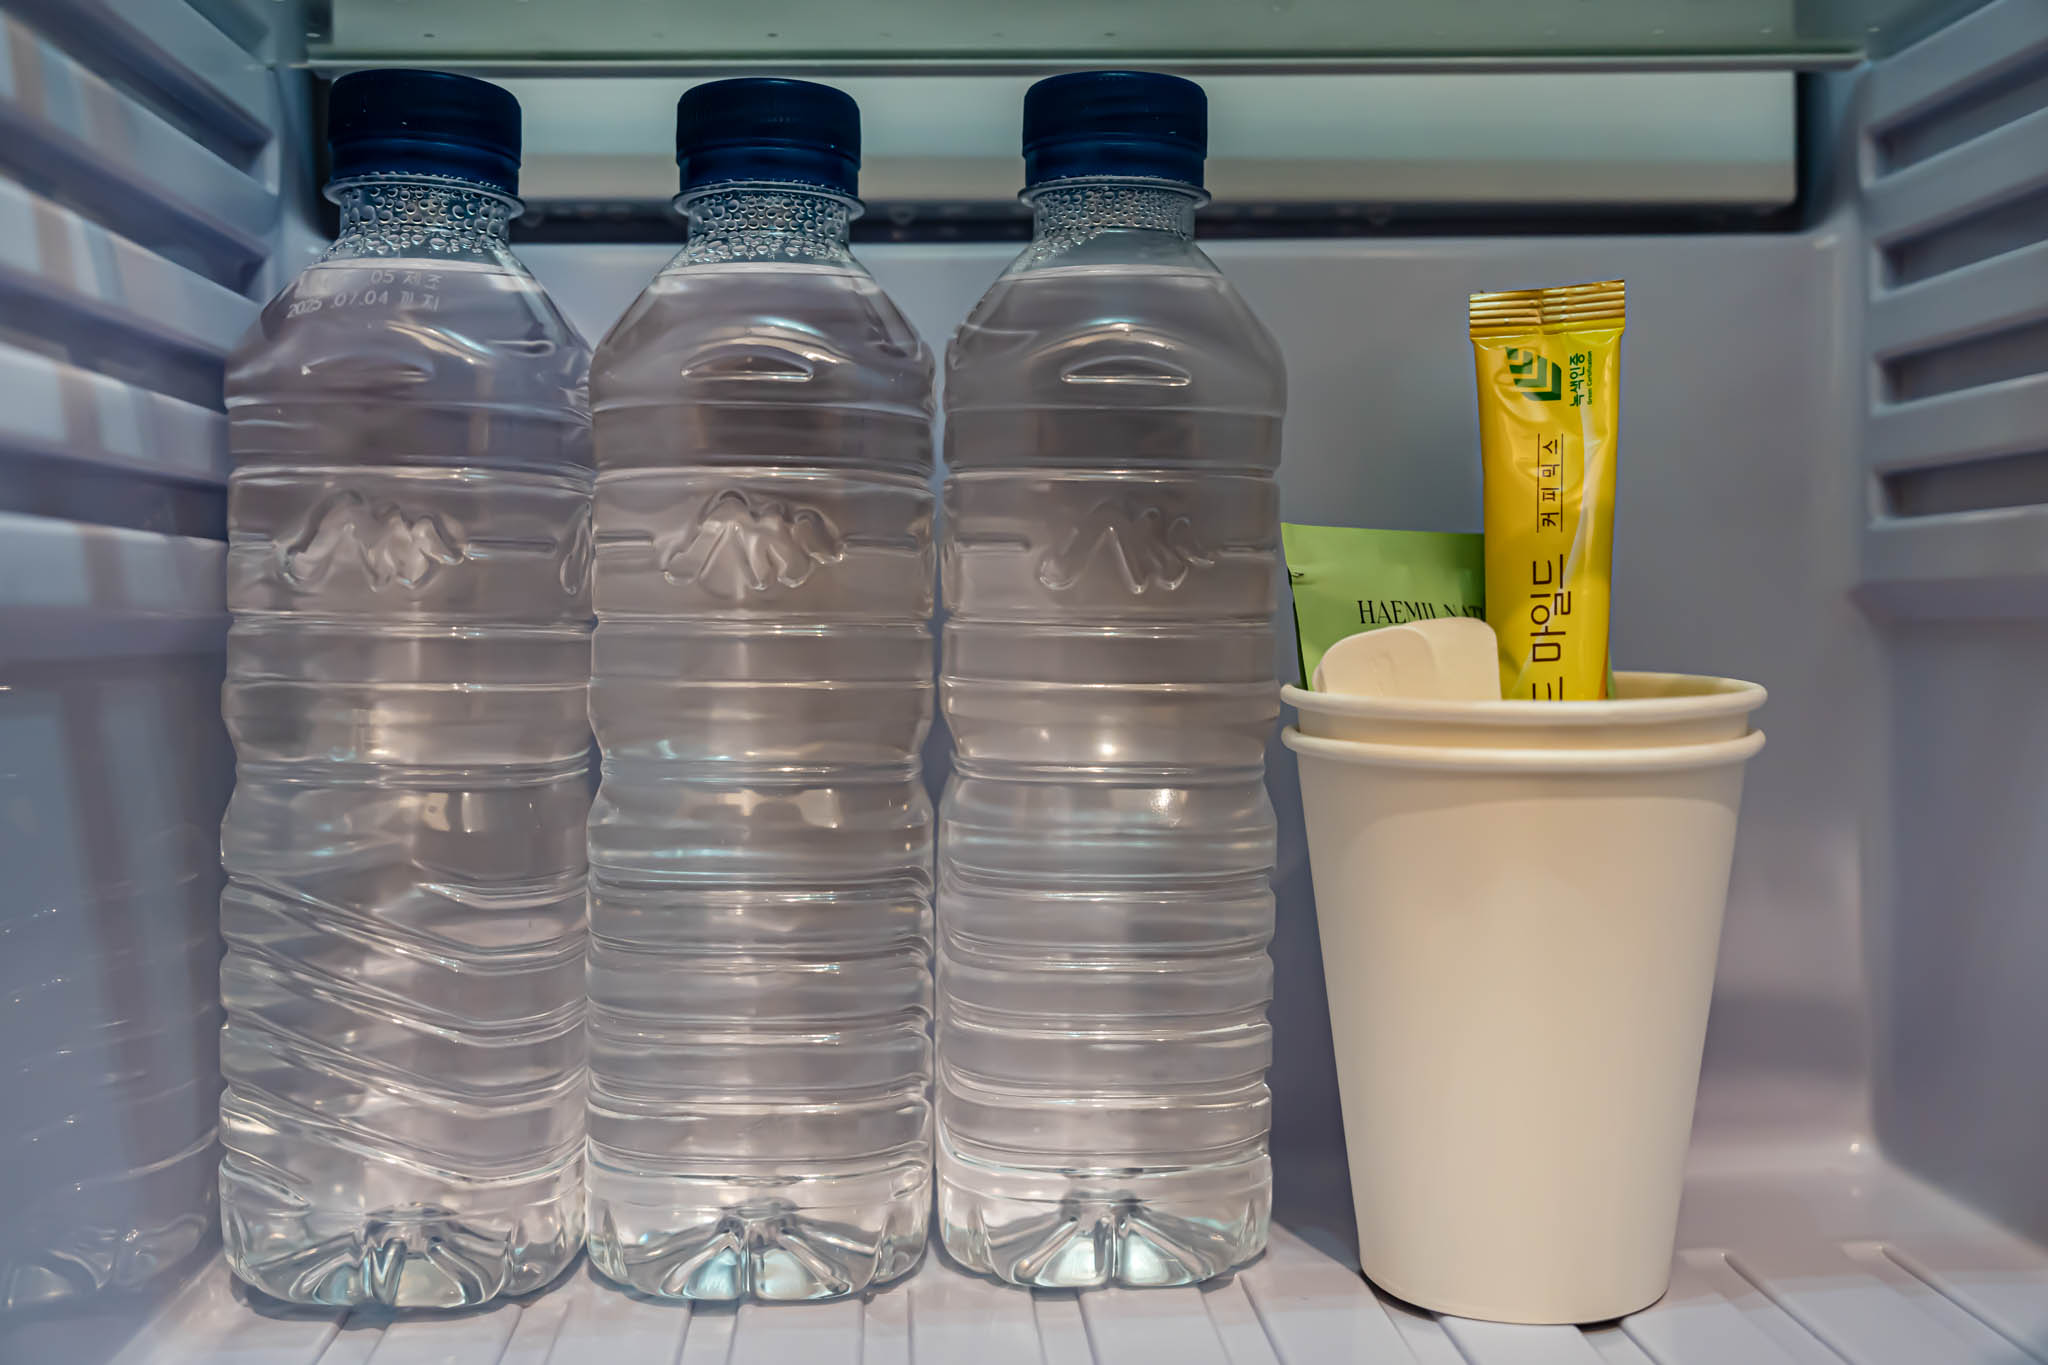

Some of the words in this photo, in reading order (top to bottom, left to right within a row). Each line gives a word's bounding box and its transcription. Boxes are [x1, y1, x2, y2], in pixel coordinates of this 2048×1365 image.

[1568, 352, 1586, 408] 녹색인증
[1540, 439, 1560, 528] 커피믹스
[1530, 553, 1572, 664] 마일드
